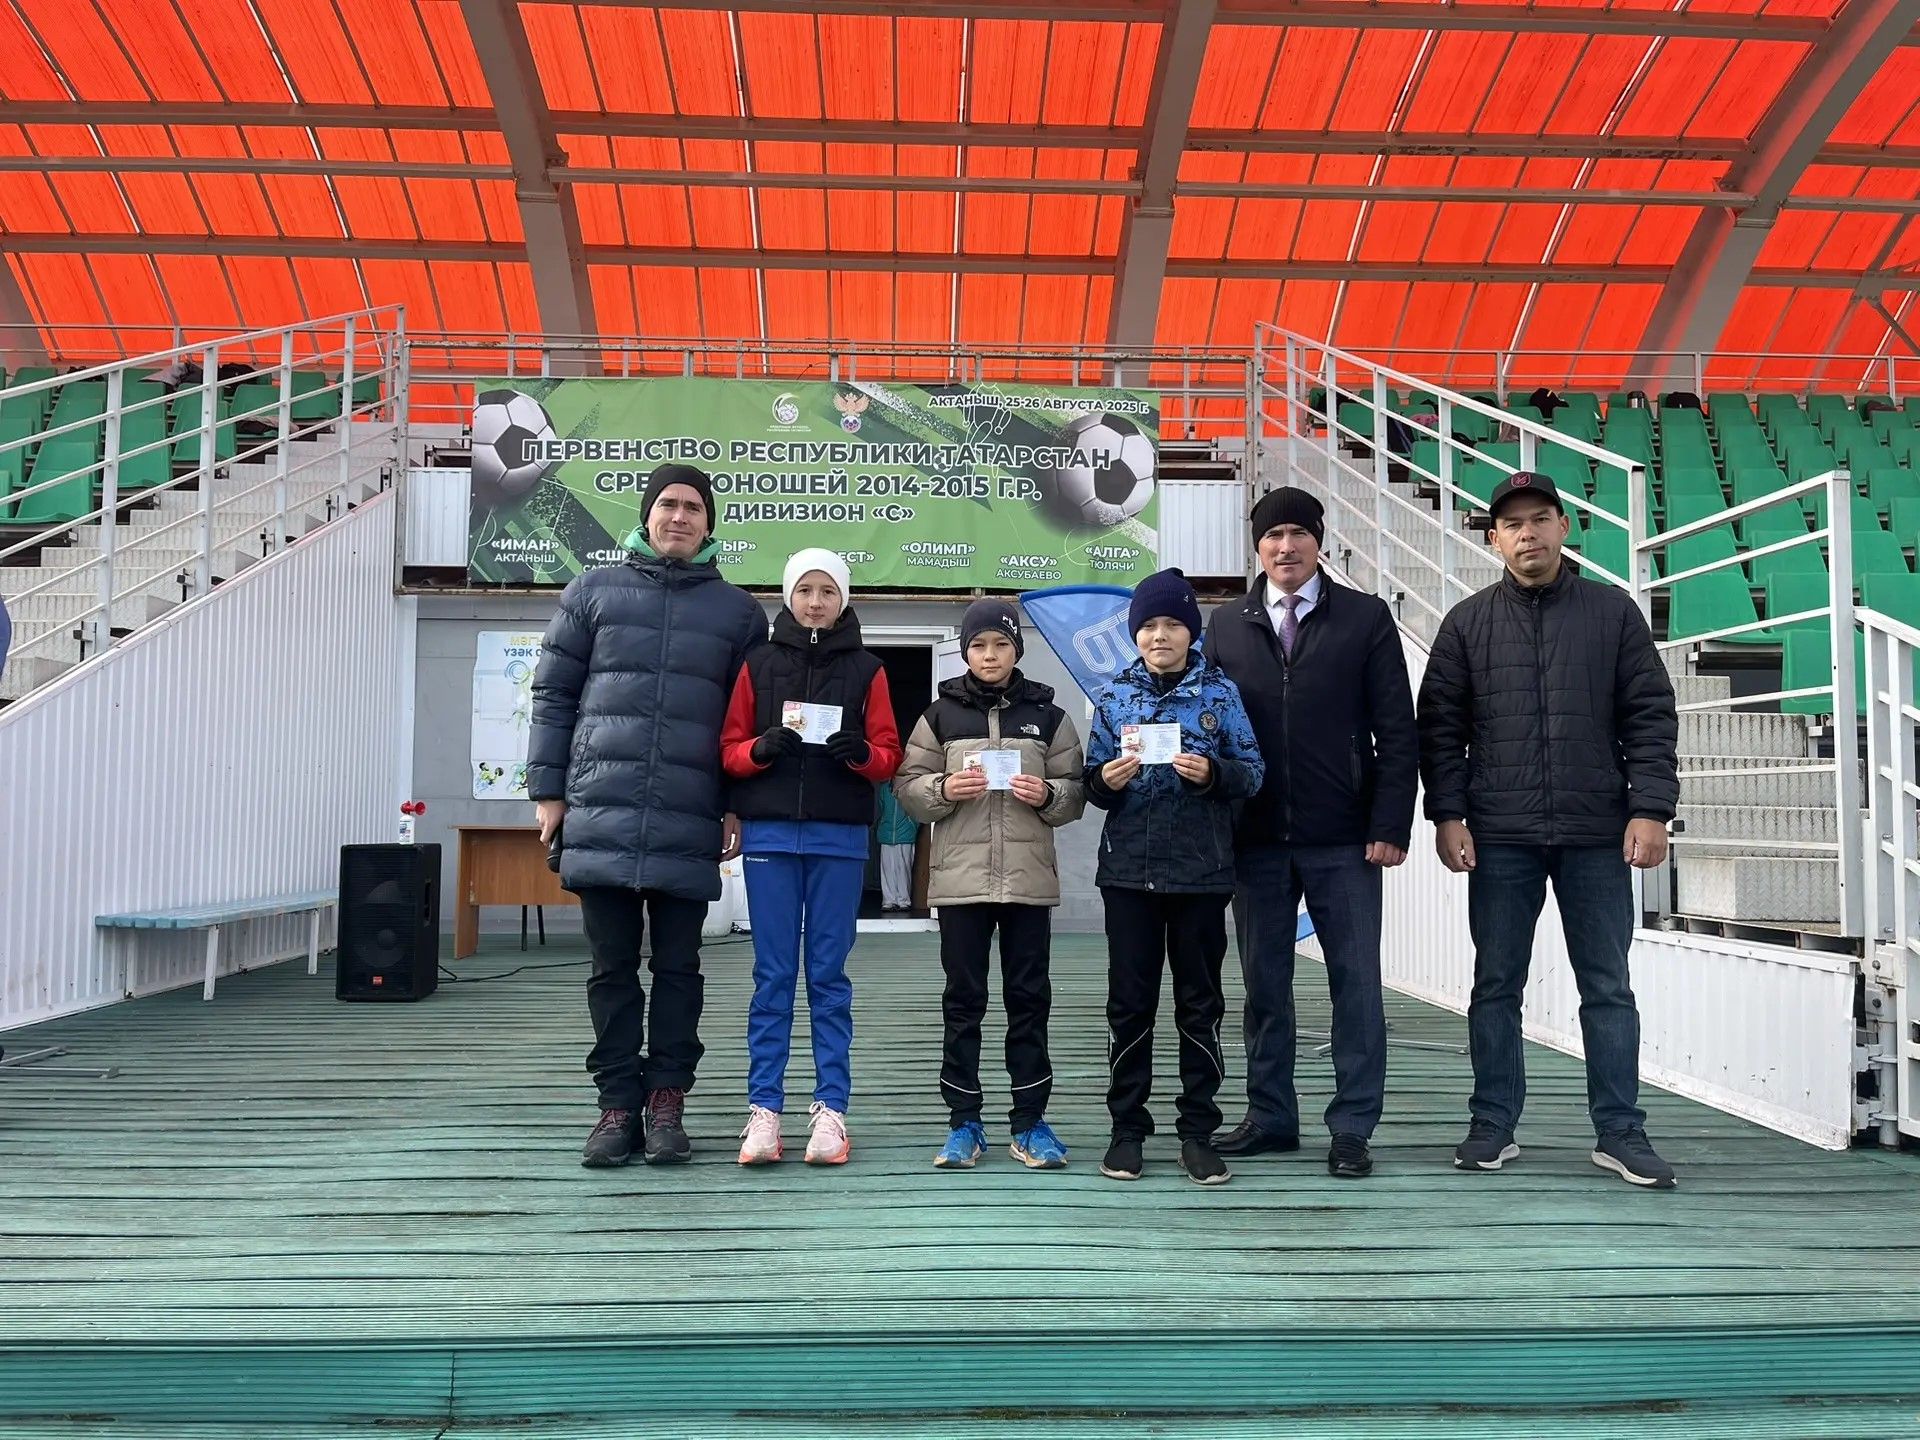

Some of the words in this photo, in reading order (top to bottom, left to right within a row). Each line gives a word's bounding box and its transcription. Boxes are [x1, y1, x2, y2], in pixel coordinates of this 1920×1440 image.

[928, 394, 1003, 409] АКТАНЫШ,
[1005, 396, 1041, 409] 25-26
[1043, 397, 1103, 411] АВГУСТА
[1106, 400, 1137, 412] 2025
[1138, 401, 1150, 414] Г.
[522, 438, 722, 462] ПЕРВЕНСТВО
[729, 441, 933, 465] РЕСПУБЛИКИ
[939, 443, 1112, 469] ТАТАРСТАН
[856, 474, 990, 498] 2014-2015
[997, 476, 1043, 500] Г.Р.
[722, 502, 866, 524] ДИВИЗИОН
[871, 503, 915, 522] «С»
[491, 538, 560, 551] «ИМАН»
[901, 542, 976, 556] «ОЛИМП»
[494, 553, 556, 563] АКТАНЫШ
[1084, 546, 1140, 559] «АЛГА»
[906, 556, 971, 568] МАМАДЫШ
[1000, 555, 1058, 568] «АКСУ»
[1089, 560, 1136, 571] ТЮЛЯЧИ
[996, 569, 1062, 580] АКСУБАЕВО
